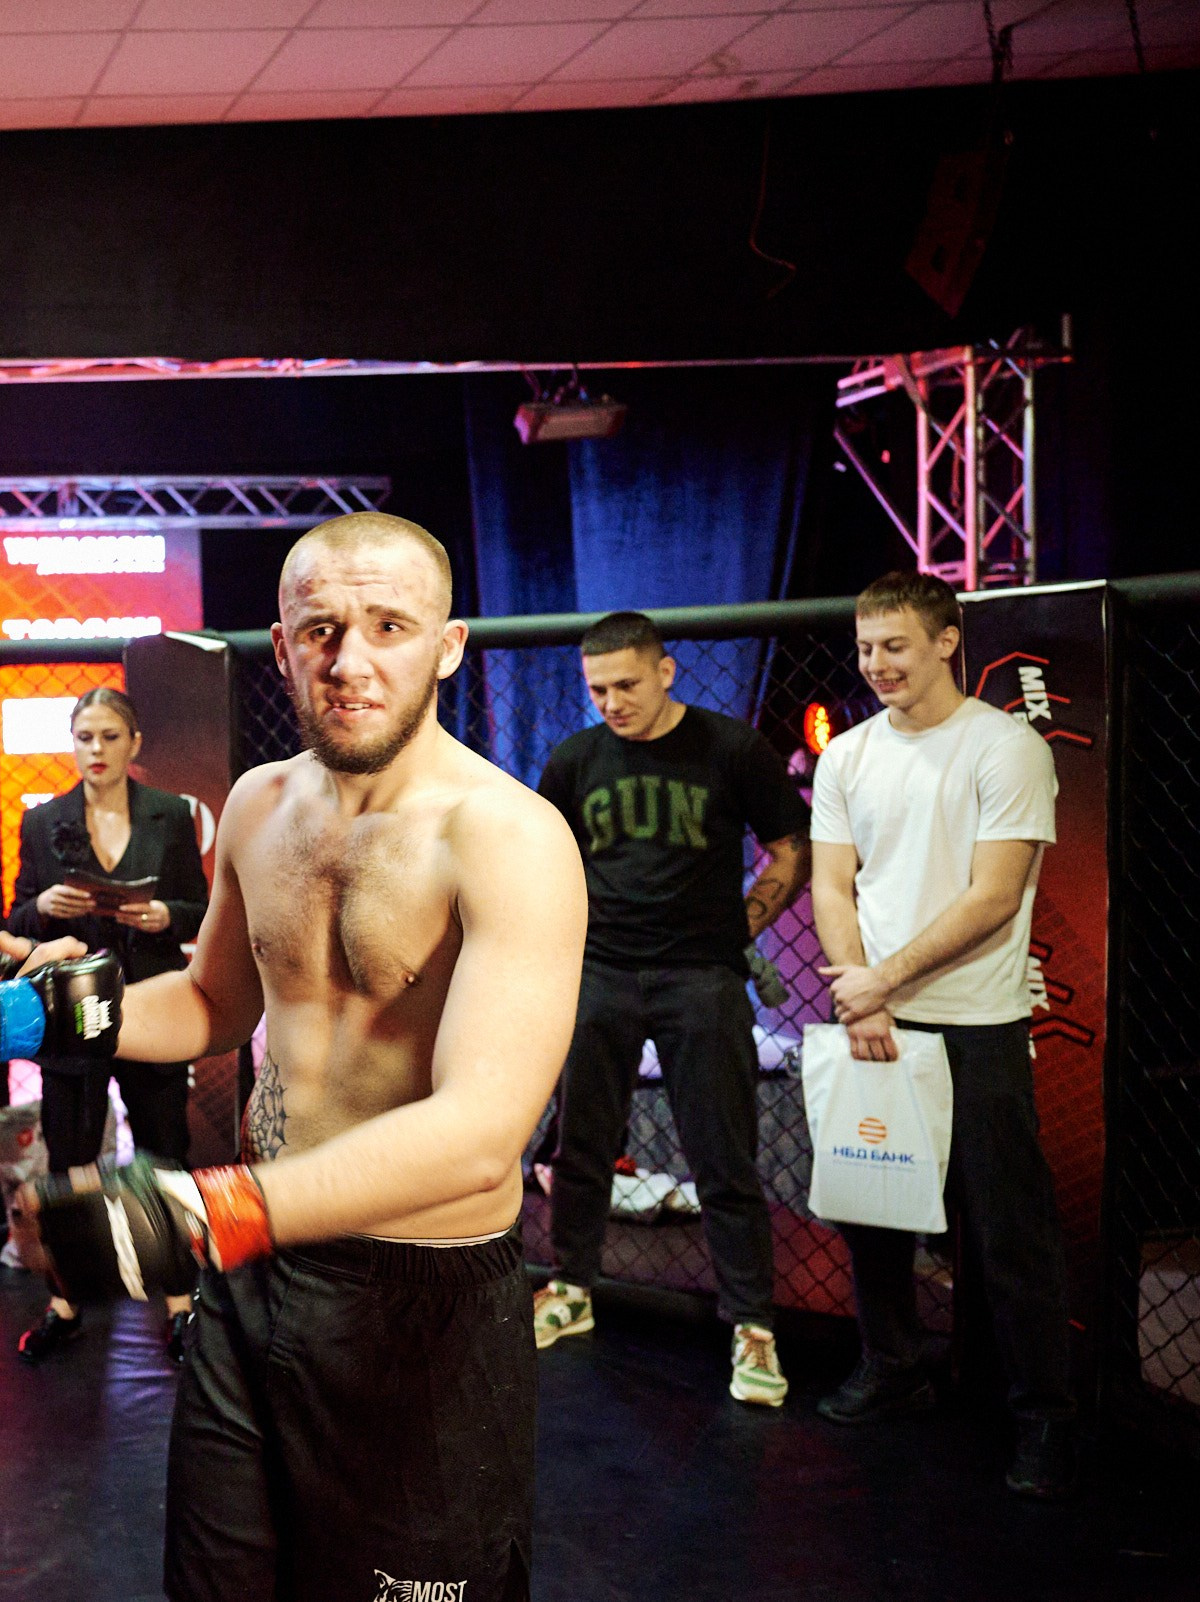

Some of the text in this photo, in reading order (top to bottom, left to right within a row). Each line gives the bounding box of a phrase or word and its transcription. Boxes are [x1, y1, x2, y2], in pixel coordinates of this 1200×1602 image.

[1017, 665, 1052, 722] MIX
[582, 775, 708, 853] GUN
[832, 1146, 916, 1164] НБД БАНК
[412, 1580, 468, 1602] MOST
